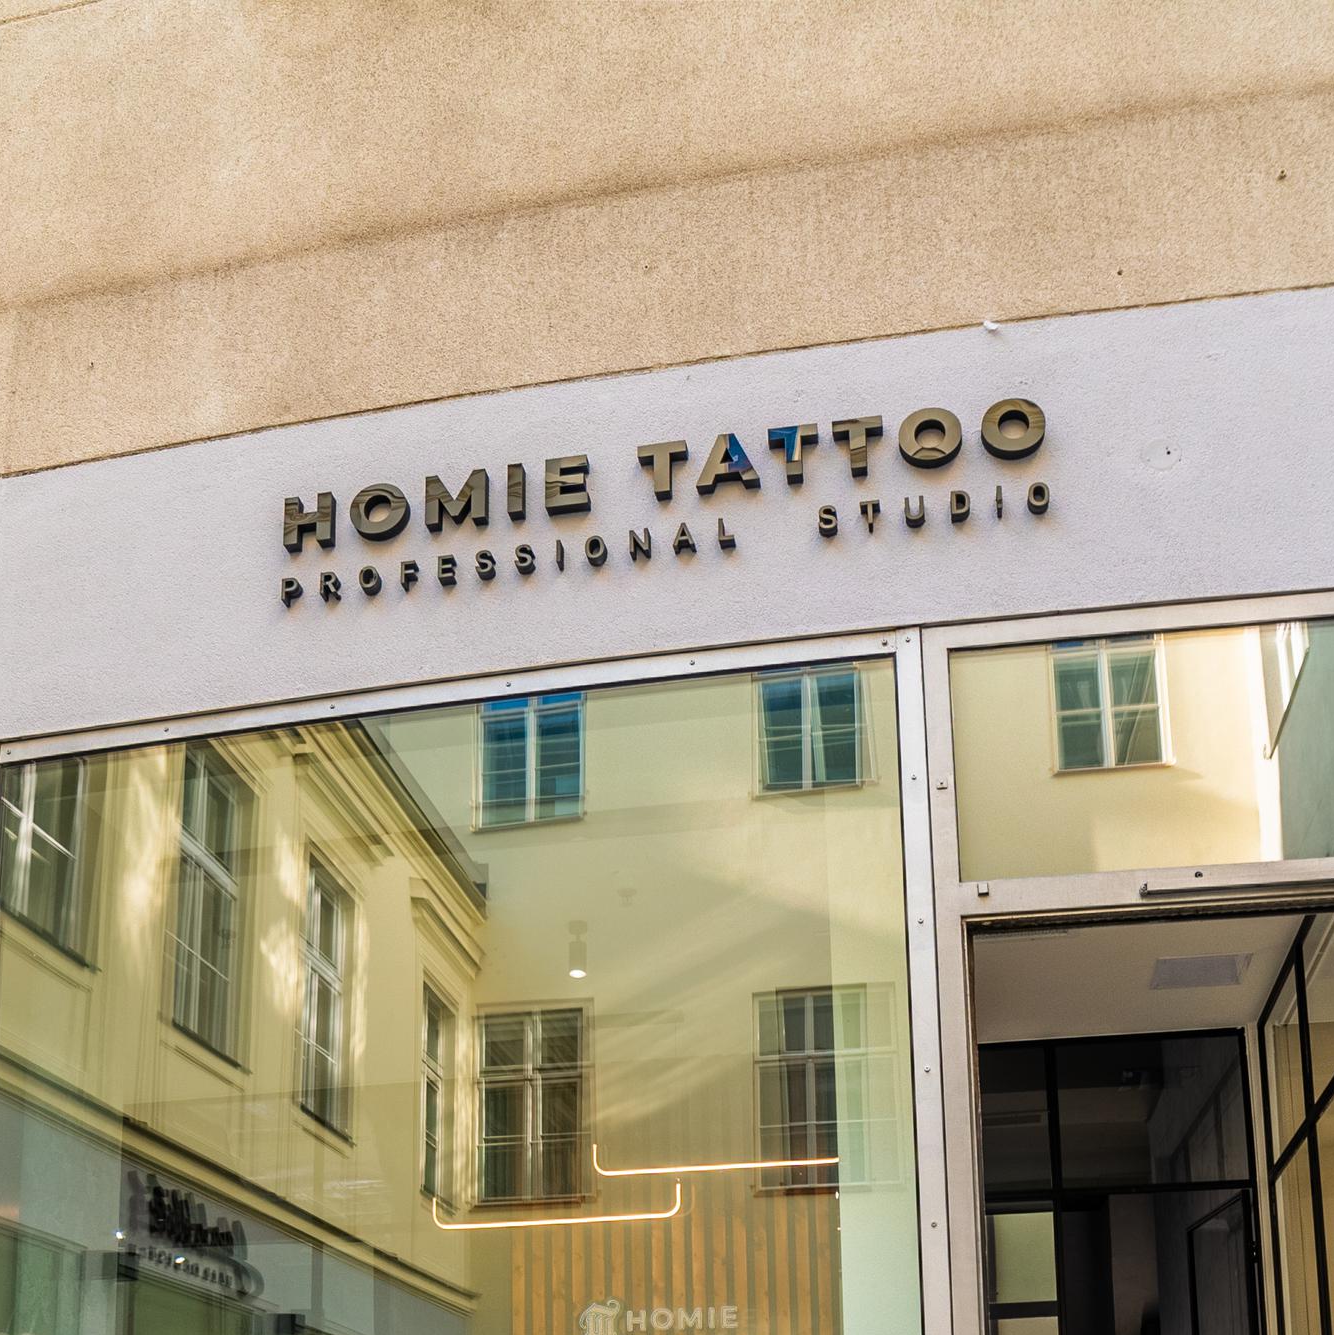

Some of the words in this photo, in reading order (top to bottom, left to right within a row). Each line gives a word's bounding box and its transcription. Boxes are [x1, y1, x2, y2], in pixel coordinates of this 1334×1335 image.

[282, 454, 593, 553] HOMIE
[636, 397, 1047, 502] TATTOO
[281, 517, 737, 608] PROFESSIONAL
[818, 481, 1051, 538] STUDIO
[625, 1304, 739, 1333] HOMIE
